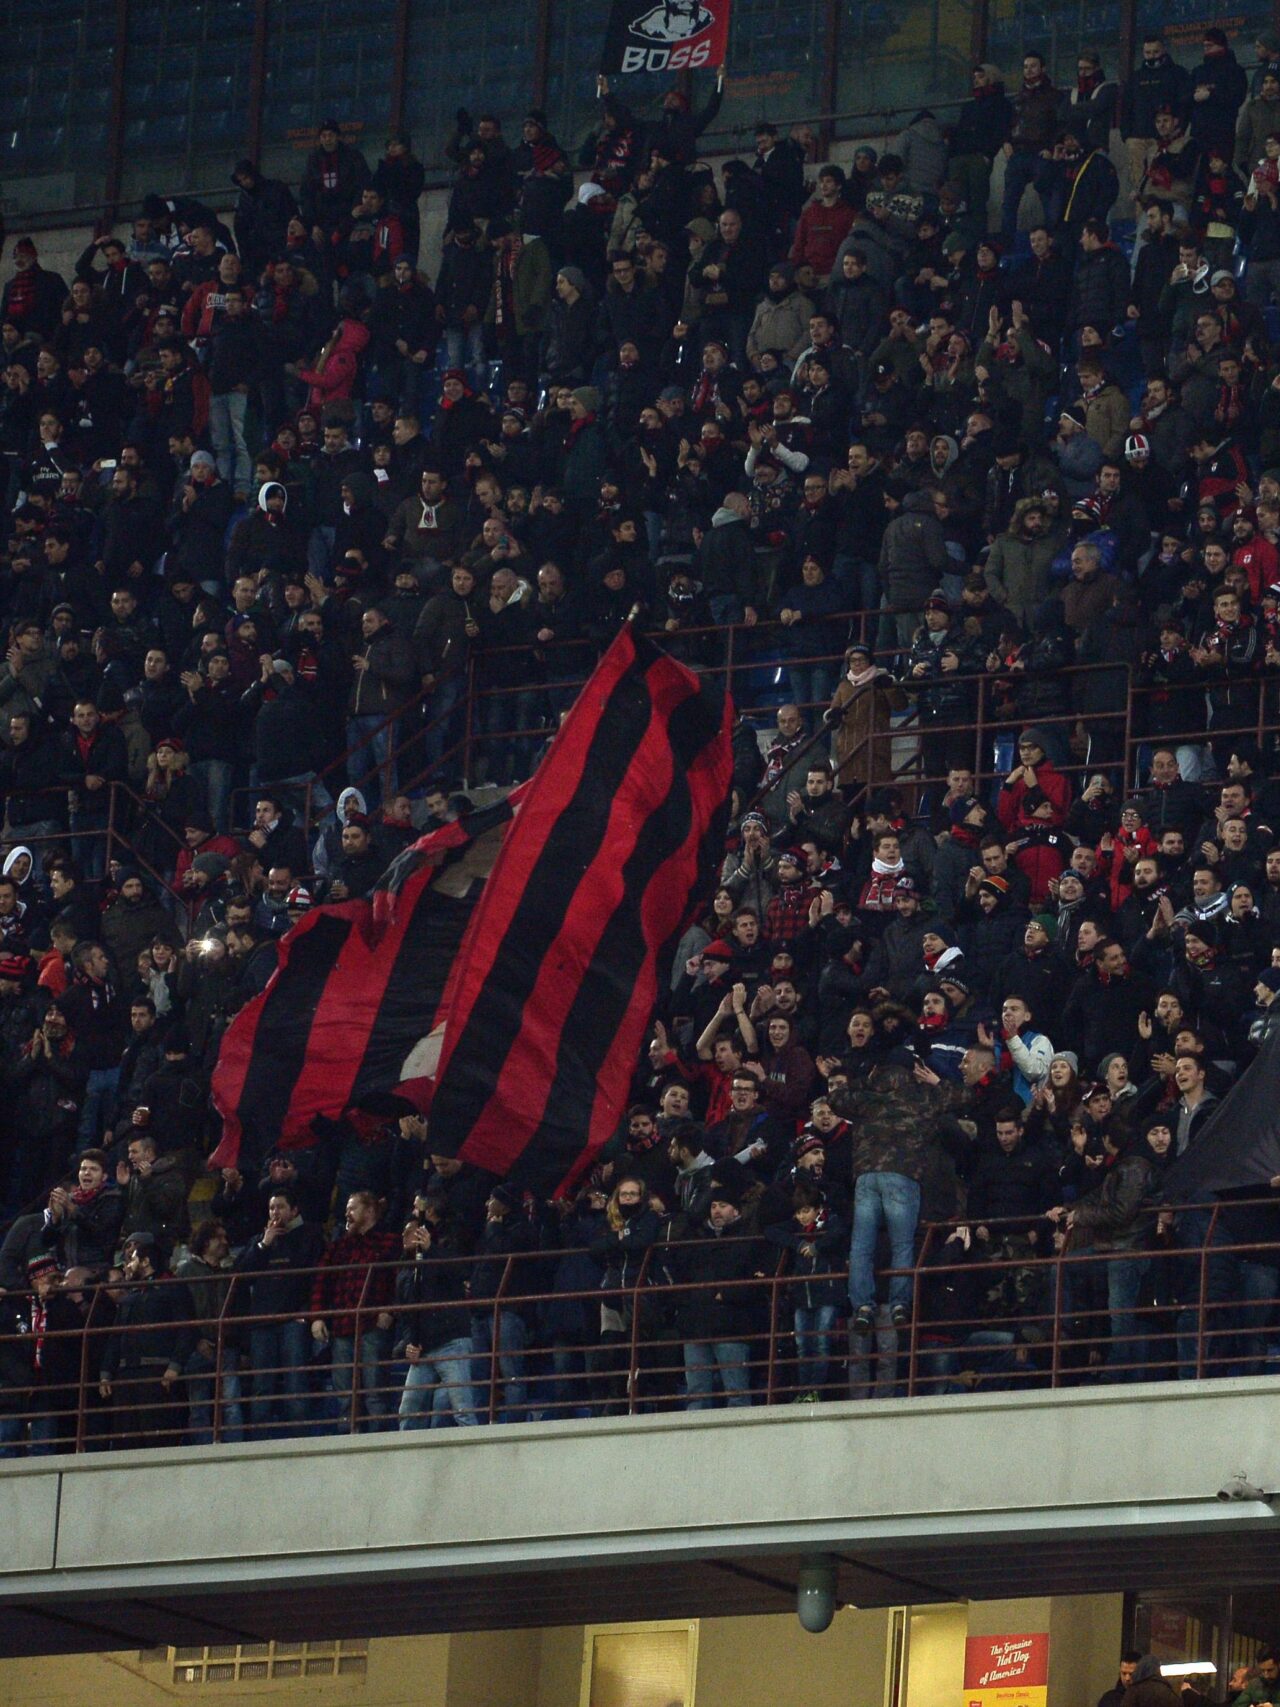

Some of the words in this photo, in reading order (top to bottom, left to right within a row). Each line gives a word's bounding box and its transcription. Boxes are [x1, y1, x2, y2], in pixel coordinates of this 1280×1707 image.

[621, 40, 710, 73] BOSS
[990, 1645, 1003, 1655] The
[1004, 1639, 1033, 1654] Genuine
[996, 1653, 1013, 1667] Hot
[1013, 1650, 1030, 1663] Dog
[979, 1672, 989, 1685] of
